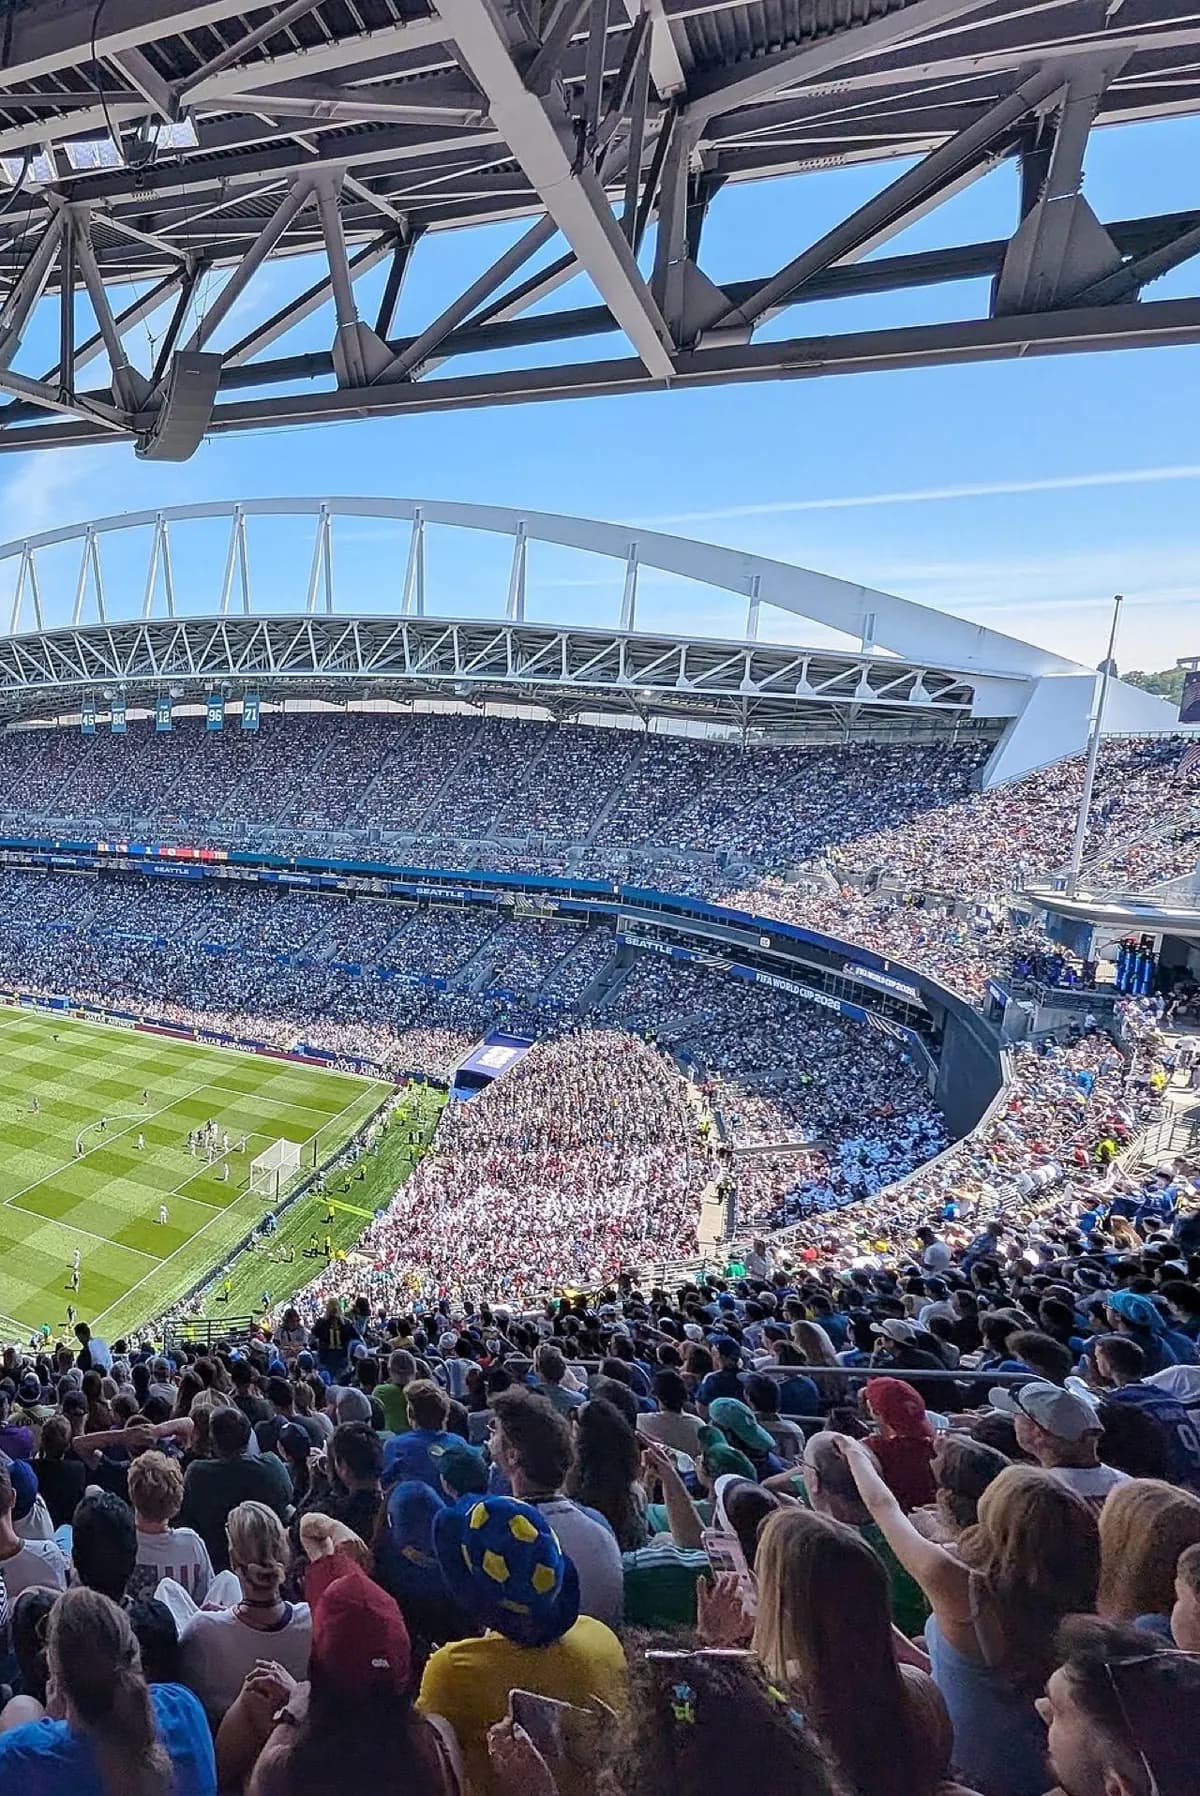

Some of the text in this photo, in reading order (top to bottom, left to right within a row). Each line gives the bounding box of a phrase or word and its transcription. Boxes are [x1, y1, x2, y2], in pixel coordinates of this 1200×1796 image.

[82, 714, 95, 727] 45
[158, 710, 170, 723] 12
[208, 709, 222, 721] 96
[244, 708, 257, 721] 71
[154, 866, 190, 875] SEATTLE
[415, 887, 465, 898] SEATTLE
[625, 937, 672, 955] SEATTLE
[756, 973, 841, 1011] FIFA WORLD CUP 2026
[85, 1013, 106, 1024] QATAR
[196, 1034, 221, 1046] QATAR
[326, 1059, 357, 1073] QATAR
